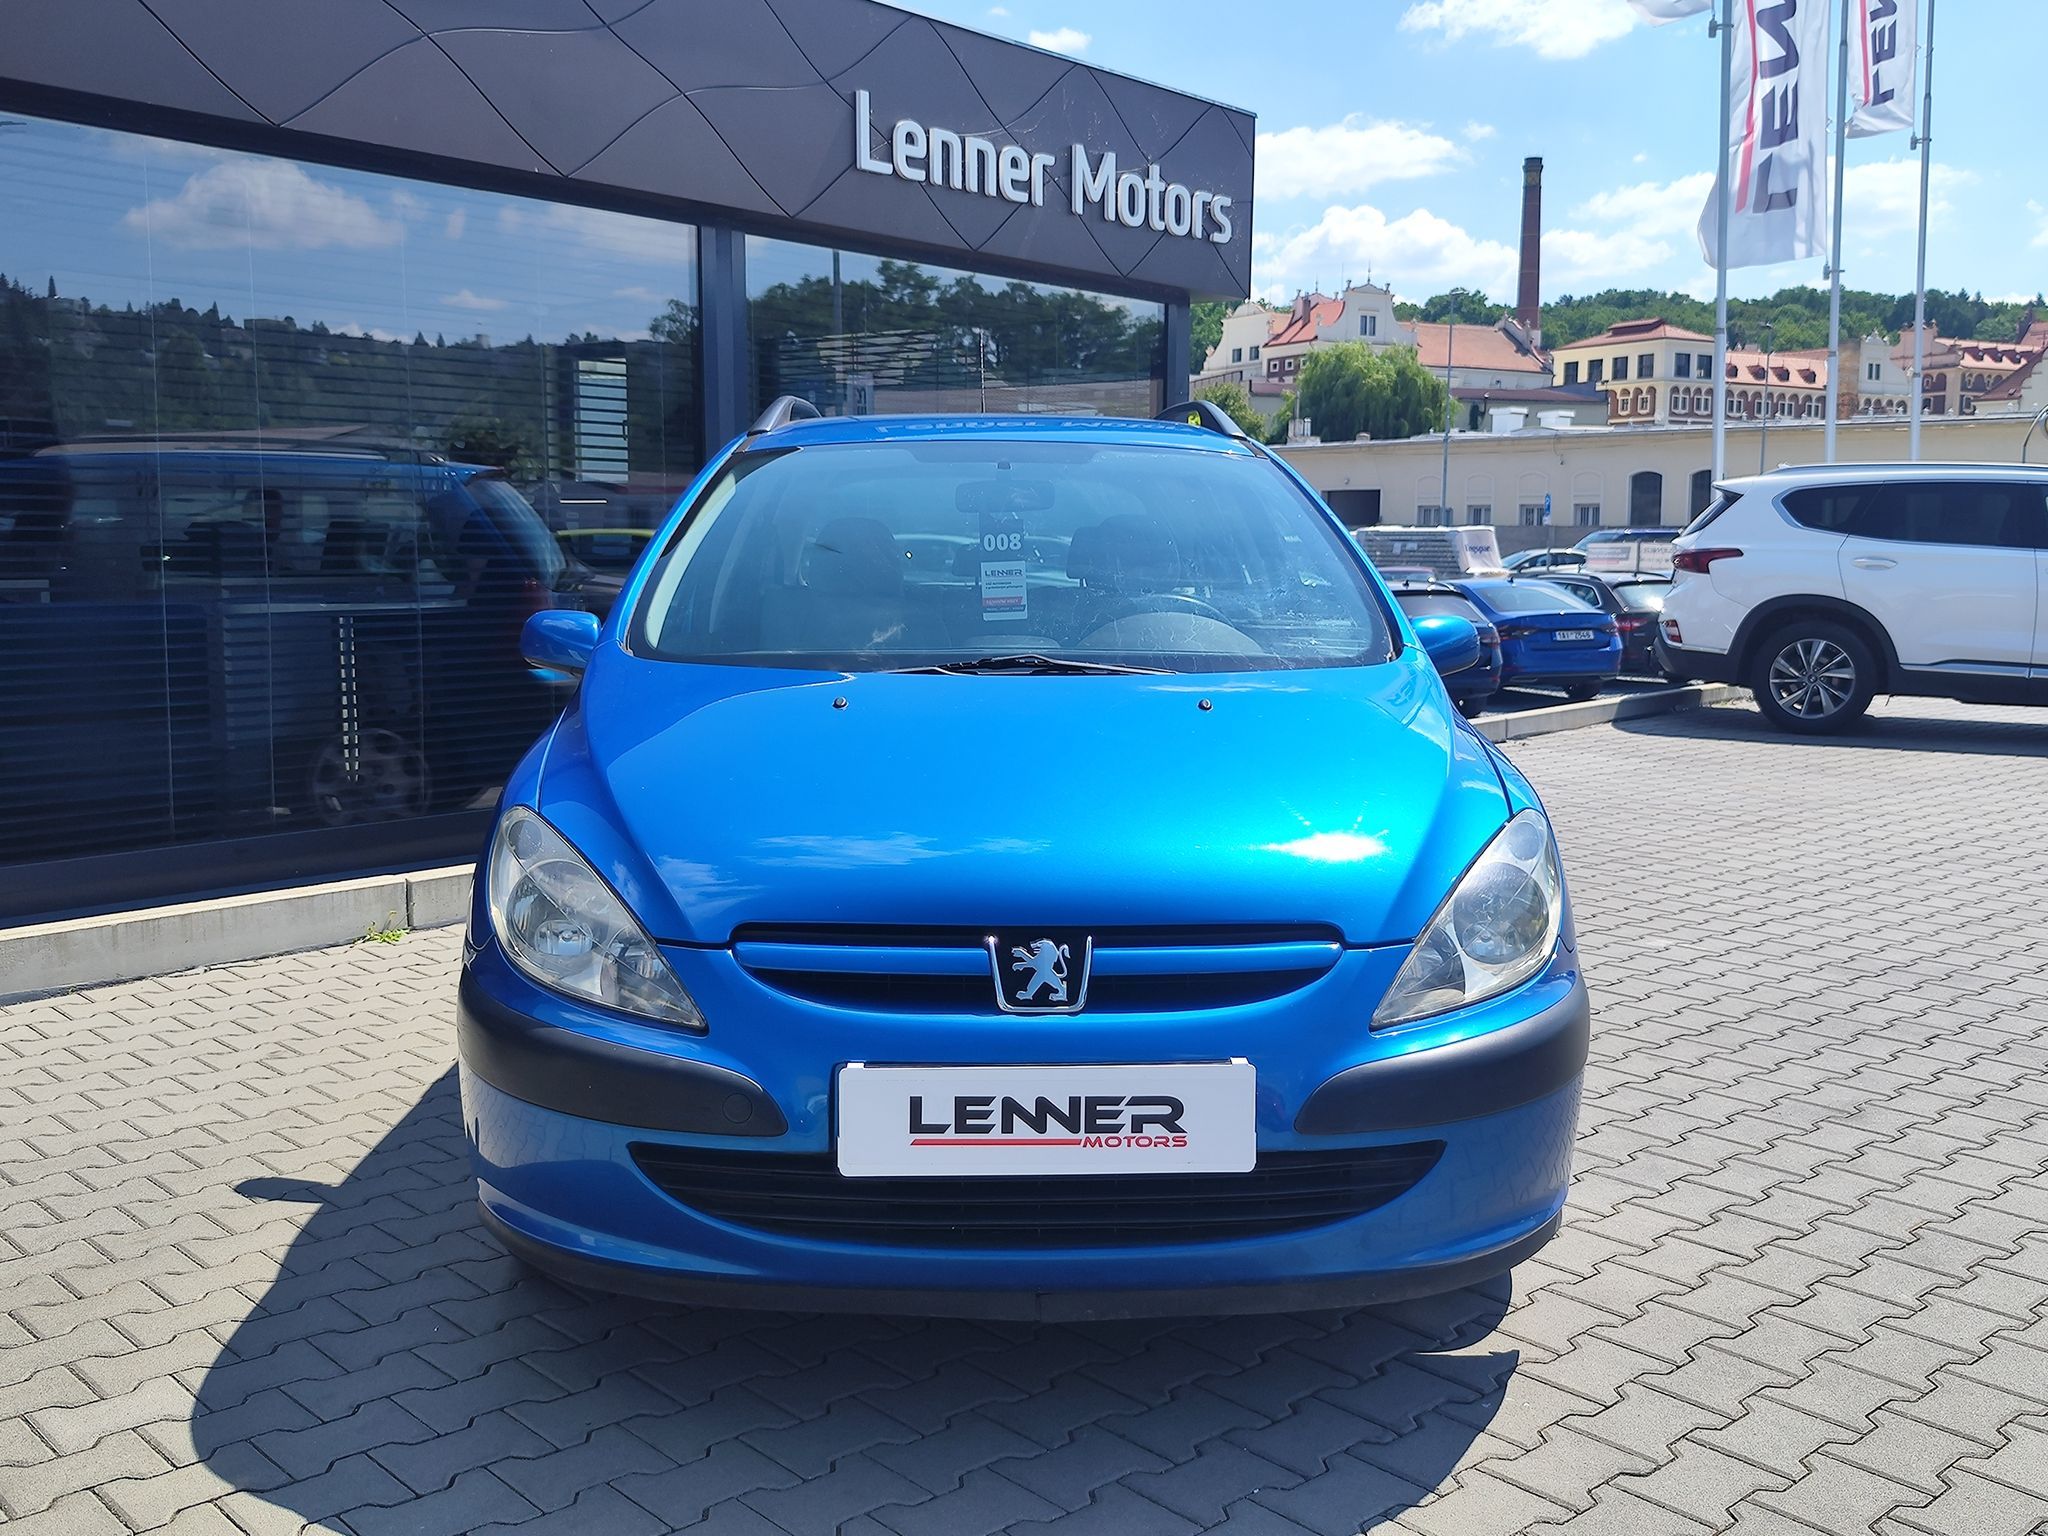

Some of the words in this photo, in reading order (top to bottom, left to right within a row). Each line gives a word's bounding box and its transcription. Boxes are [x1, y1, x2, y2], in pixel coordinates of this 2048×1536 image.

[855, 89, 1056, 207] Lenner
[1071, 143, 1234, 244] Motors
[983, 533, 1022, 551] 008
[985, 568, 1022, 577] LENNER
[909, 1095, 1186, 1135] LENNER
[1083, 1135, 1188, 1148] MOTORS
